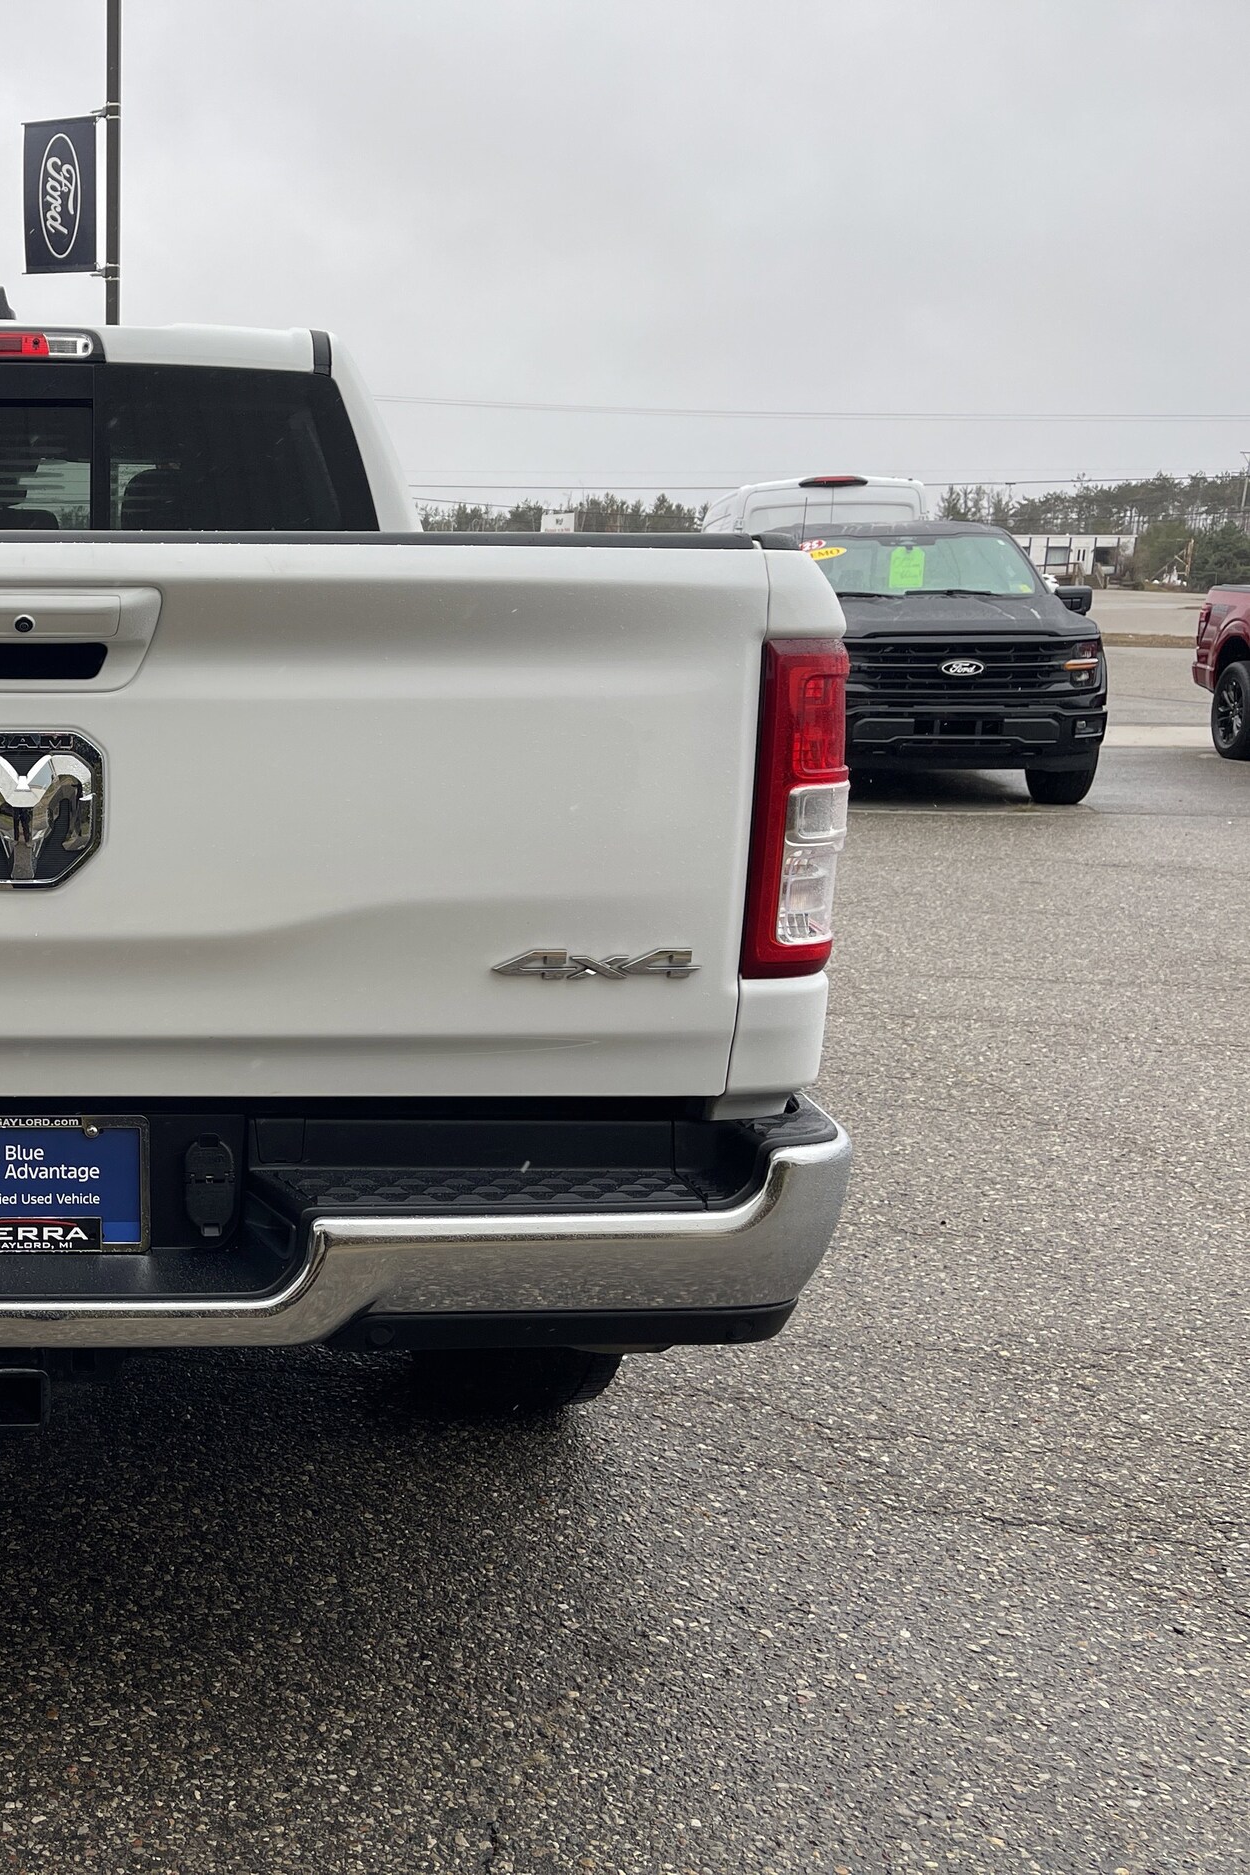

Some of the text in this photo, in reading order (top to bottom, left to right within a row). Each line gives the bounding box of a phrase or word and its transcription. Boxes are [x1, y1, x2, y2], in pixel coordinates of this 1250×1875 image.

[46, 156, 76, 235] Ford
[810, 548, 840, 559] EMO
[949, 662, 977, 674] Ford
[5, 1144, 45, 1161] Blue
[4, 1163, 100, 1182] Advantage
[21, 1193, 53, 1205] Used
[56, 1193, 101, 1205] Vehicle
[59, 1241, 73, 1249] MI
